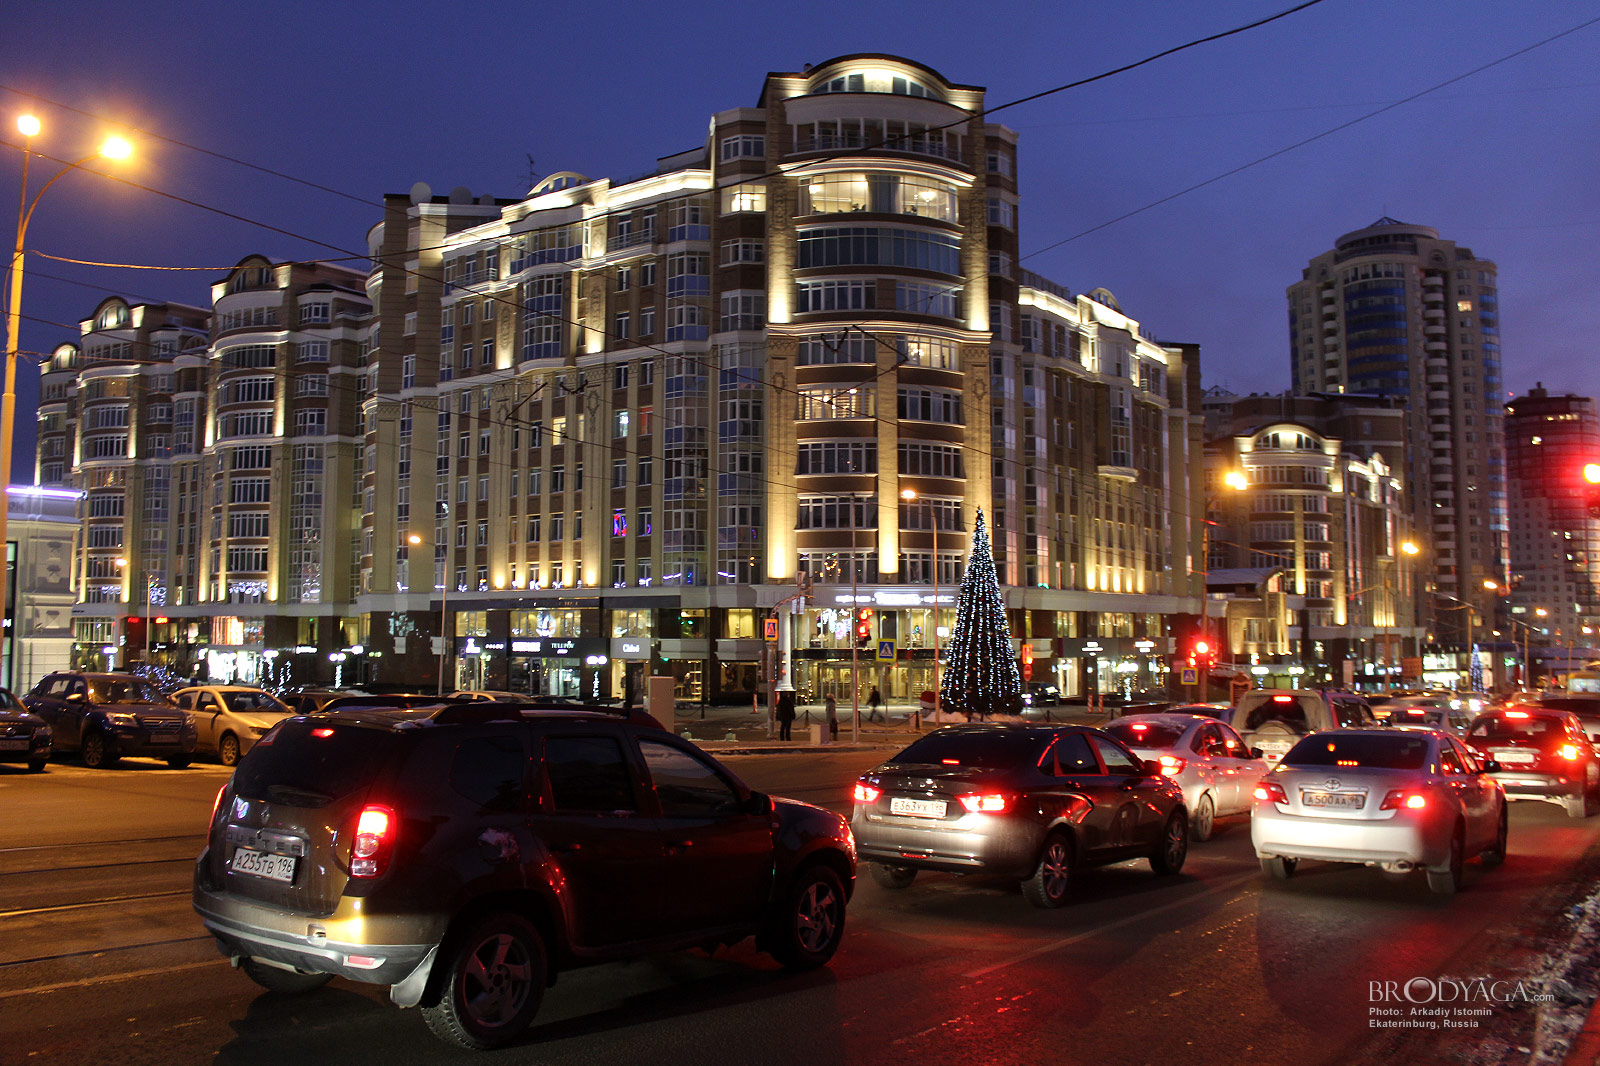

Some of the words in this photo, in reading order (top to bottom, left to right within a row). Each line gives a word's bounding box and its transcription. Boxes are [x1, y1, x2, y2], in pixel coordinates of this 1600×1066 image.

[226, 833, 301, 854] DUSTER
[235, 853, 275, 874] A255TB
[277, 858, 293, 873] 196
